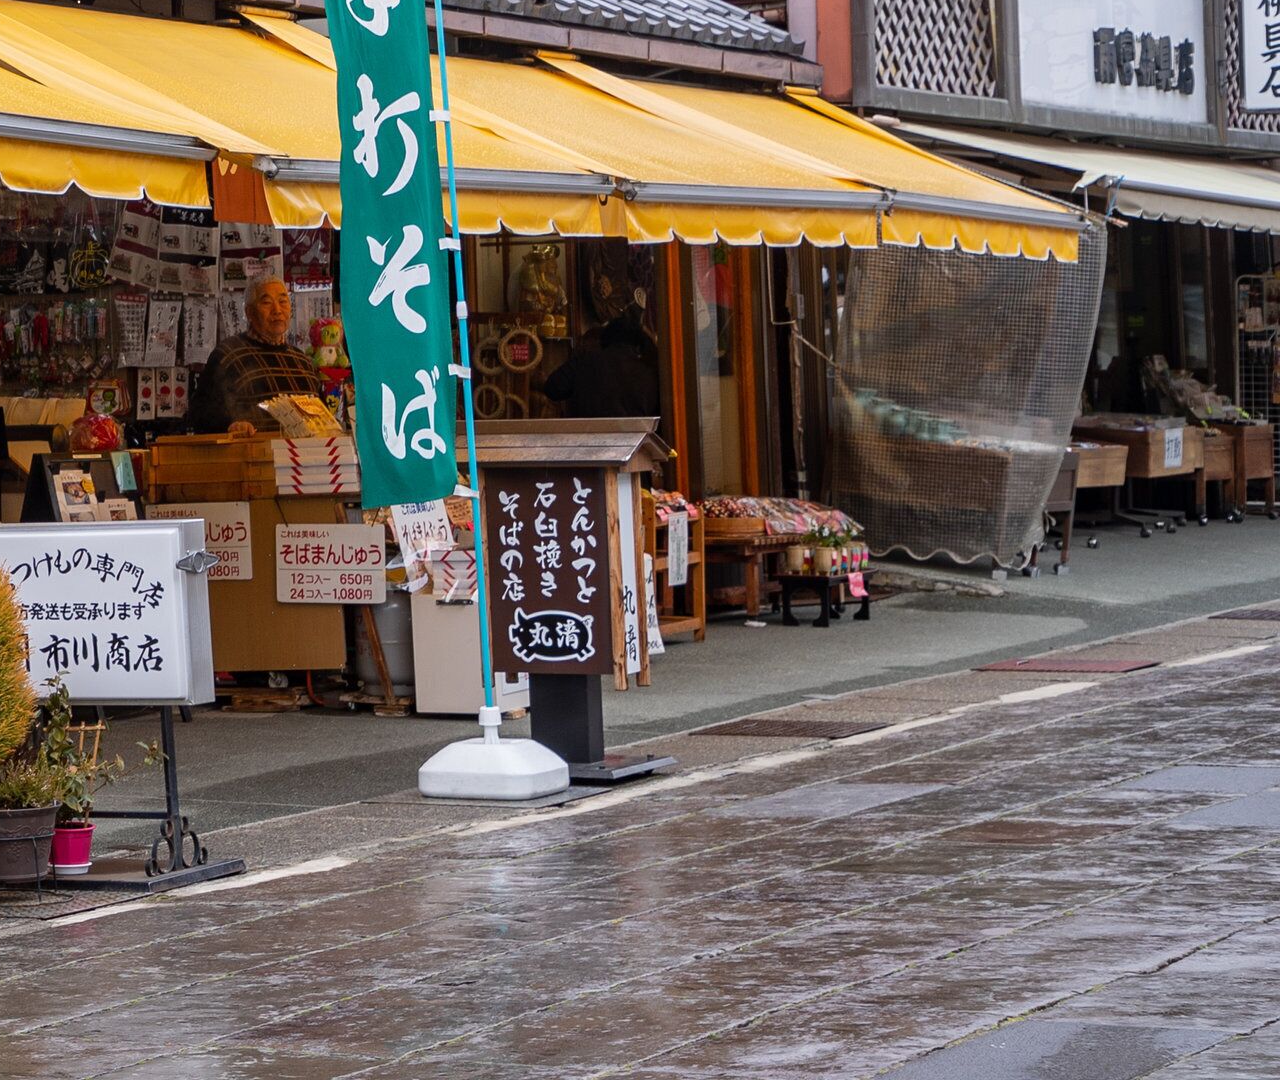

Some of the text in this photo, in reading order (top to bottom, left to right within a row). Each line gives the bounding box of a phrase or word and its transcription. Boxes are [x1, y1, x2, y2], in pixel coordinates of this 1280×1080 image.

[150, 509, 197, 518] これは美味しい
[204, 521, 248, 543] じゅう
[280, 530, 330, 538] これは美味しい
[498, 490, 526, 602] そばの店
[533, 481, 563, 598] 石臼挽き
[571, 476, 597, 604] とんかつと
[279, 543, 382, 565] そばまんじゅう
[10, 547, 165, 610] つけもの専門店
[339, 573, 373, 585] 650円
[528, 619, 581, 650] 丸清
[39, 633, 164, 673] 市川商店
